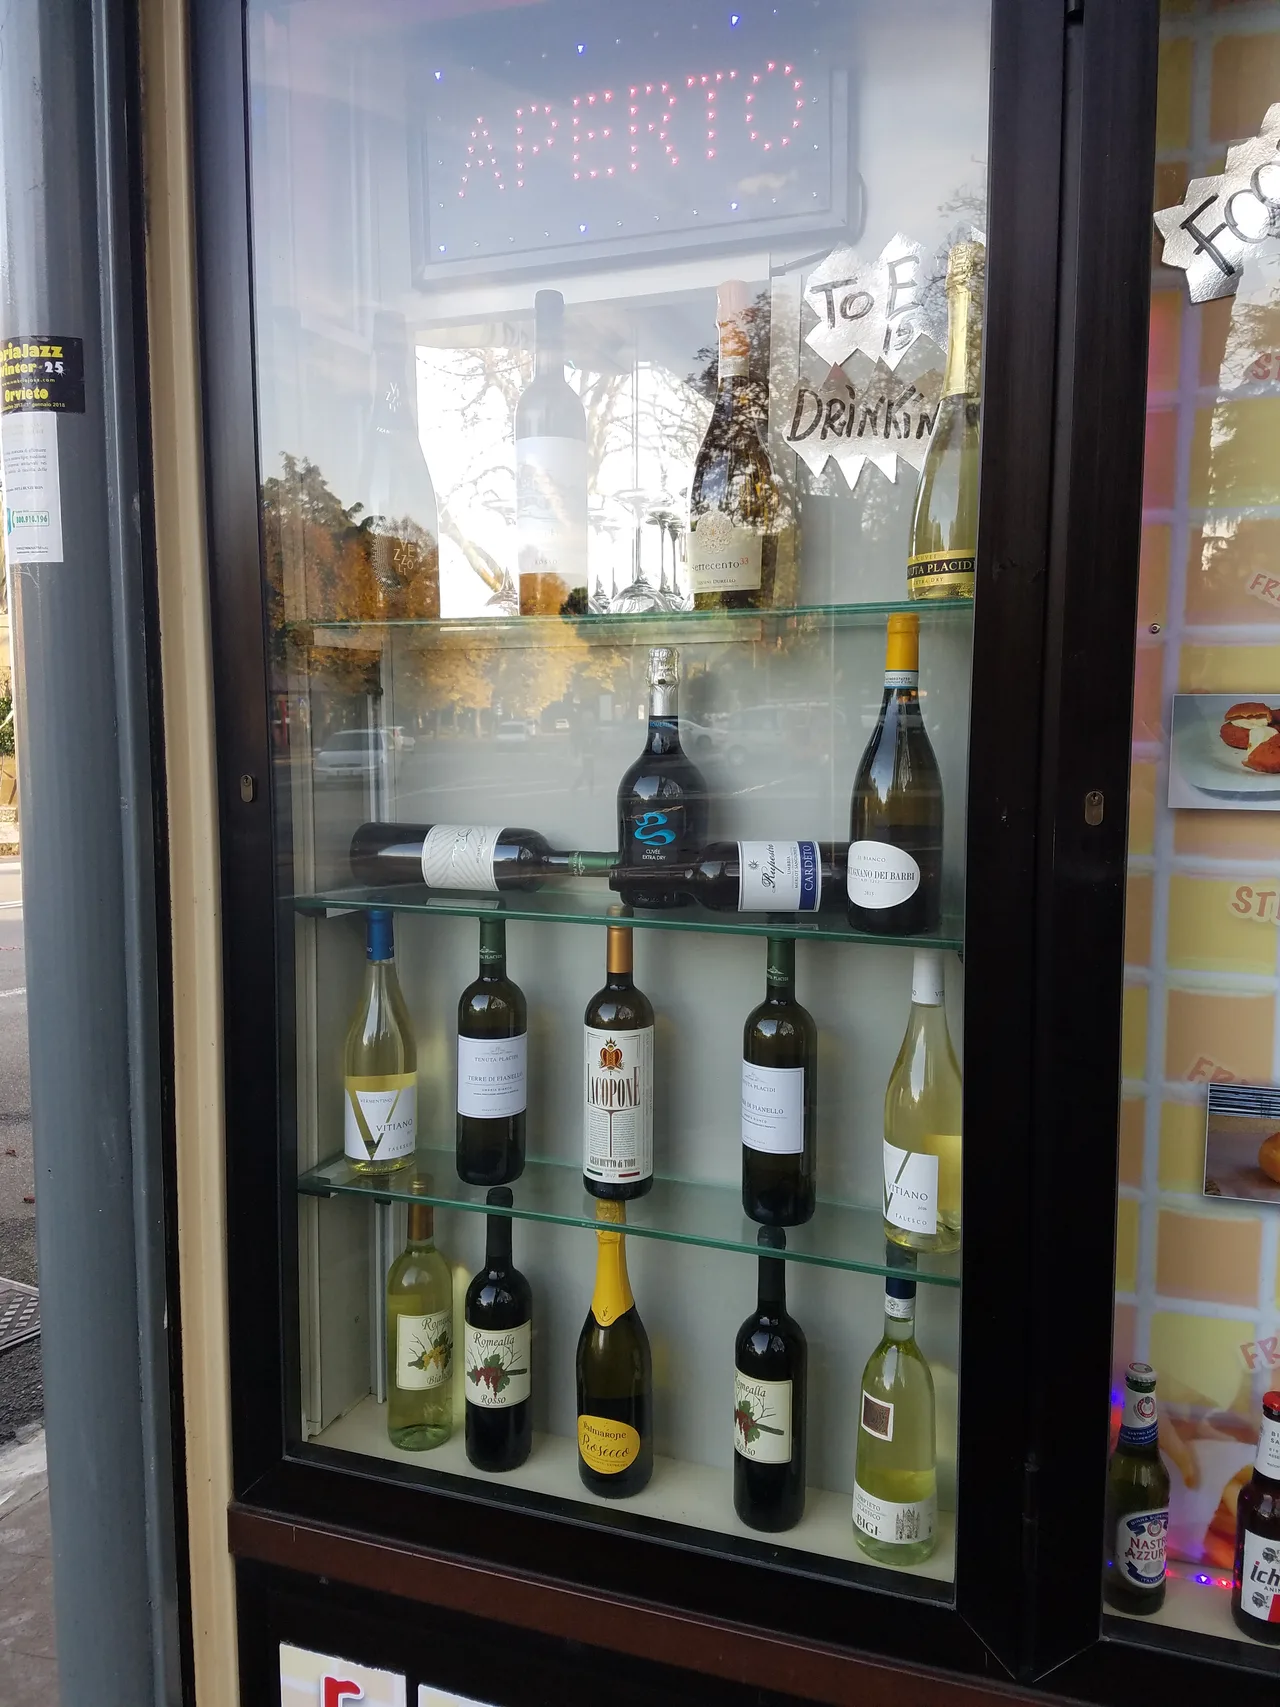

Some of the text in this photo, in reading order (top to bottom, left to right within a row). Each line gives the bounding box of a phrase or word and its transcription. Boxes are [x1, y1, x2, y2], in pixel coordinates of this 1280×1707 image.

[457, 60, 803, 197] APERTO
[44, 361, 65, 374] 25
[4, 386, 49, 403] Orvieto
[1249, 572, 1280, 602] FR
[802, 845, 814, 891] CARDETO
[874, 870, 888, 880] DEI
[890, 871, 915, 881] BARBI
[1231, 885, 1280, 920] ST
[753, 1085, 776, 1093] PLACIDI
[752, 1103, 784, 1115] FIANELLO
[376, 1118, 413, 1132] VITIANO
[887, 1181, 929, 1201] VITIANO
[472, 1331, 515, 1348] Romealla
[480, 1393, 507, 1407] Rosso
[581, 1433, 630, 1458] Prosecco
[856, 1502, 881, 1521] CLASSICO
[855, 1512, 879, 1537] BIGI
[1130, 1536, 1167, 1550] NASTR
[1125, 1547, 1166, 1561] AZZUR
[1249, 1560, 1280, 1587] ich
